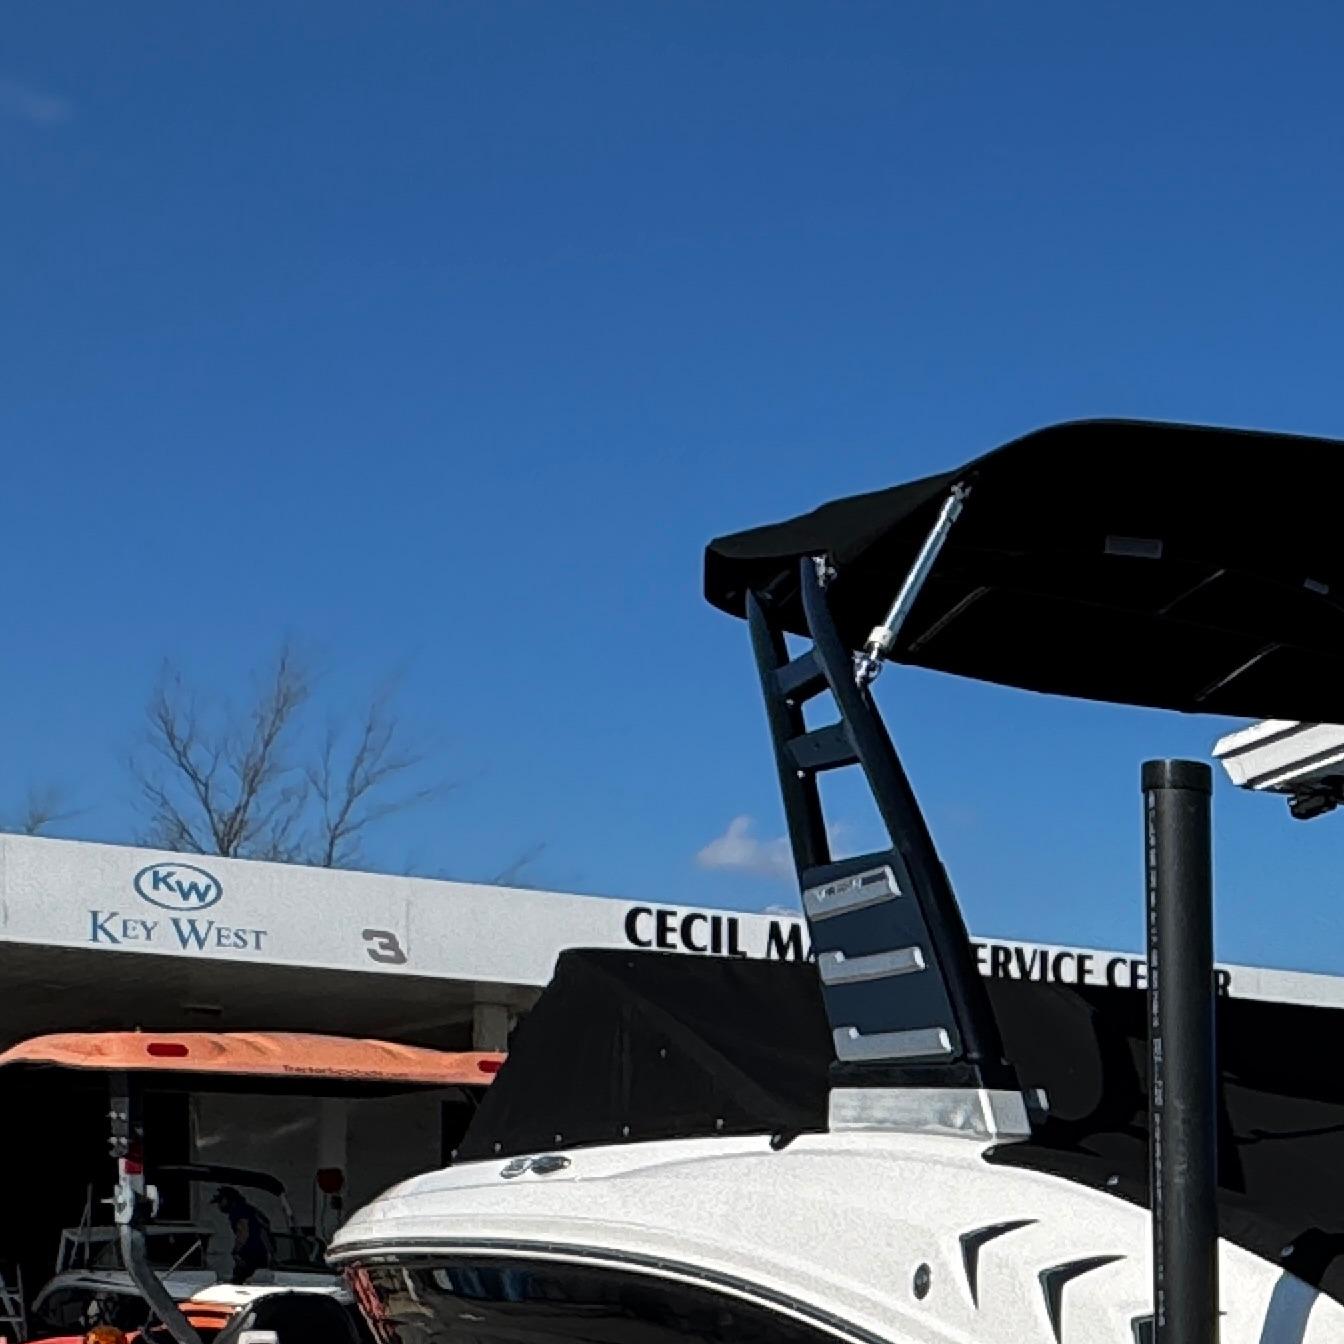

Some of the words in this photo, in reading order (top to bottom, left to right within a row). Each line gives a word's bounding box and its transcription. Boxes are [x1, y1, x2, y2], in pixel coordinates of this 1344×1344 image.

[151, 870, 212, 903] KW
[362, 928, 408, 964] 3
[624, 906, 747, 957] CECIL
[969, 942, 1094, 985] ERVICE
